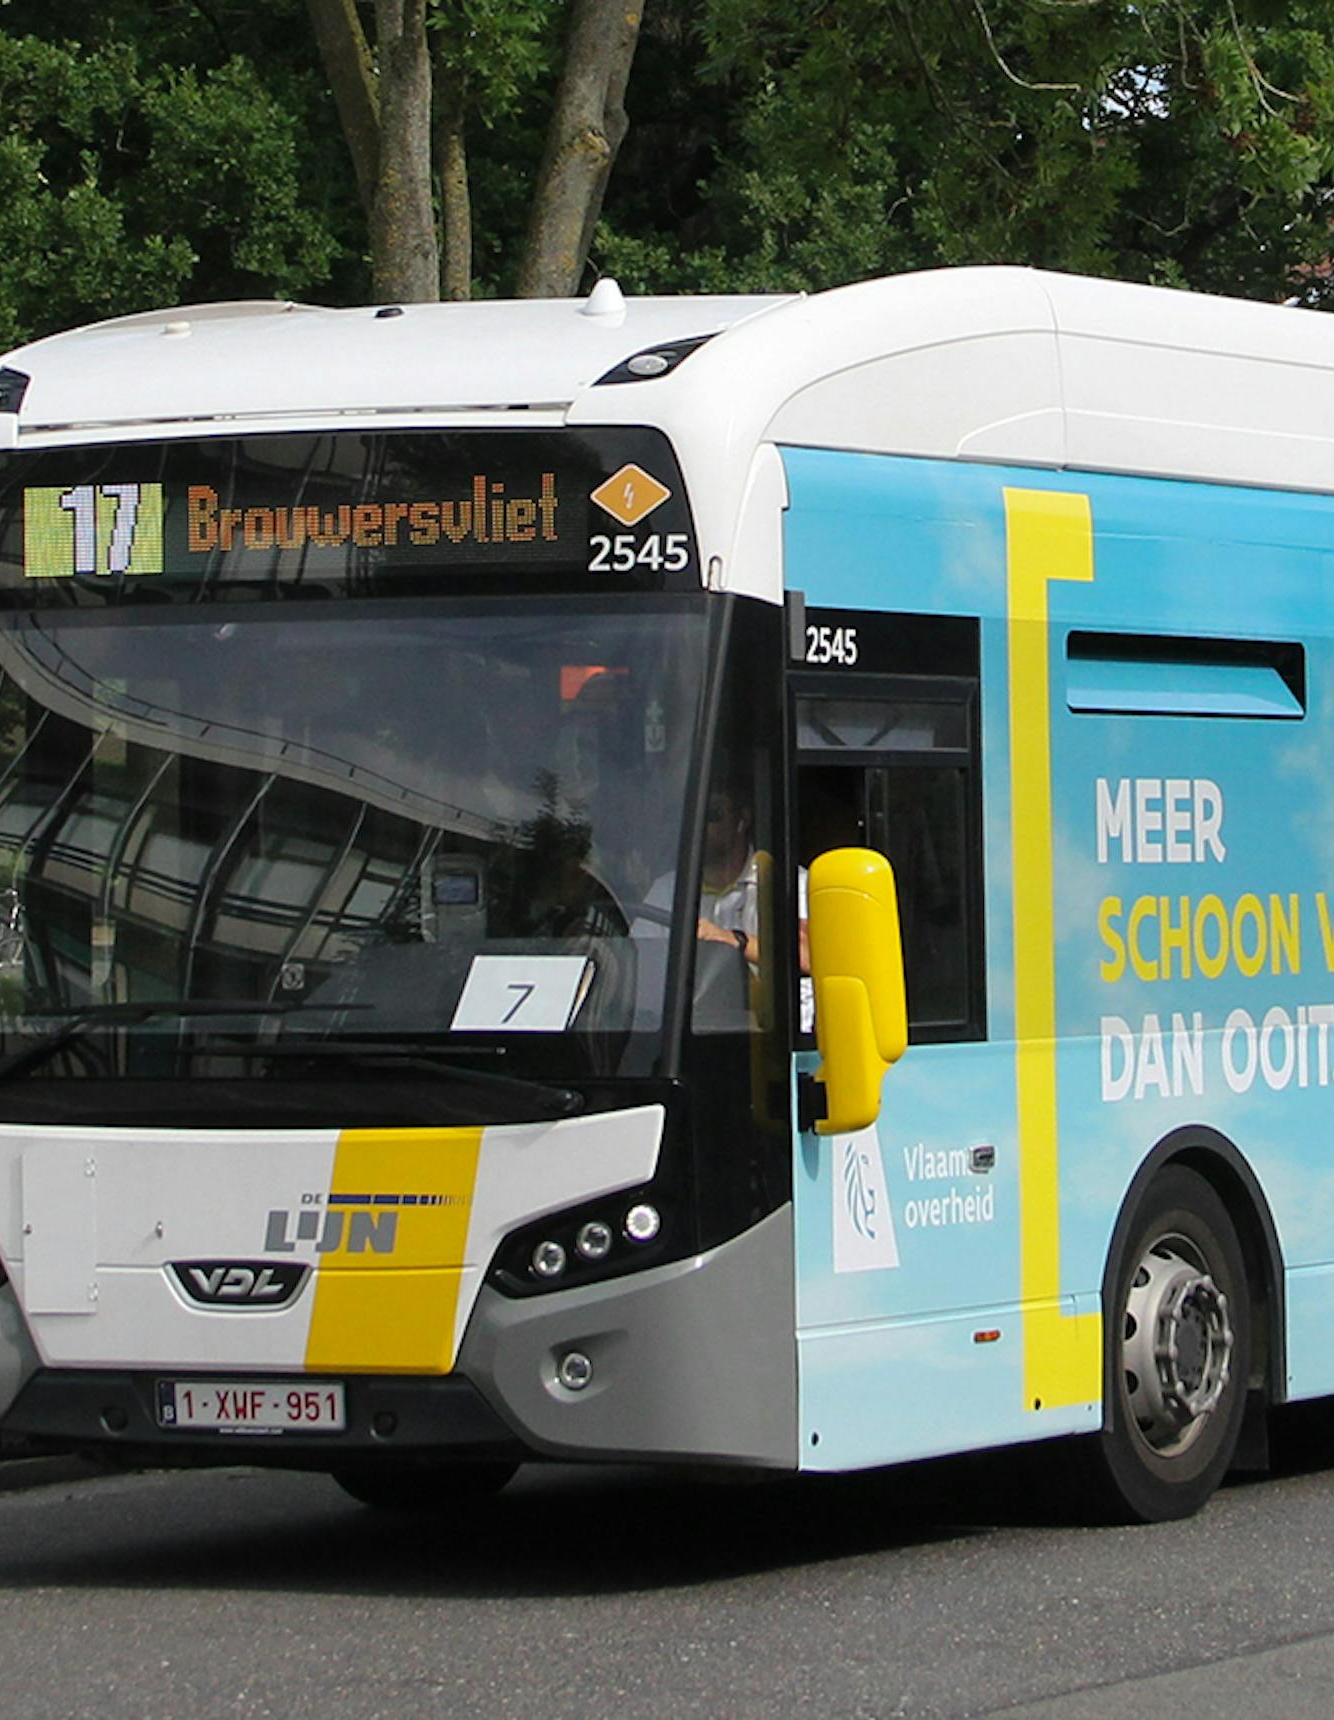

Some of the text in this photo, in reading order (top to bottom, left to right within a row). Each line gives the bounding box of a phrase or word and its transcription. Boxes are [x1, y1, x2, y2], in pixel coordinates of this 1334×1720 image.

[61, 472, 559, 573] 17 Brouwersvliet
[588, 534, 689, 572] 2545
[806, 625, 858, 665] 2545
[1095, 778, 1227, 863] MEER
[1098, 893, 1301, 983] SCHOON
[501, 983, 536, 1024] 7
[1100, 1012, 1204, 1101] DAN
[903, 1143, 998, 1181] Vlaam
[904, 1184, 995, 1229] overheid
[264, 1211, 398, 1253] LIJN
[188, 1267, 285, 1297] VDL
